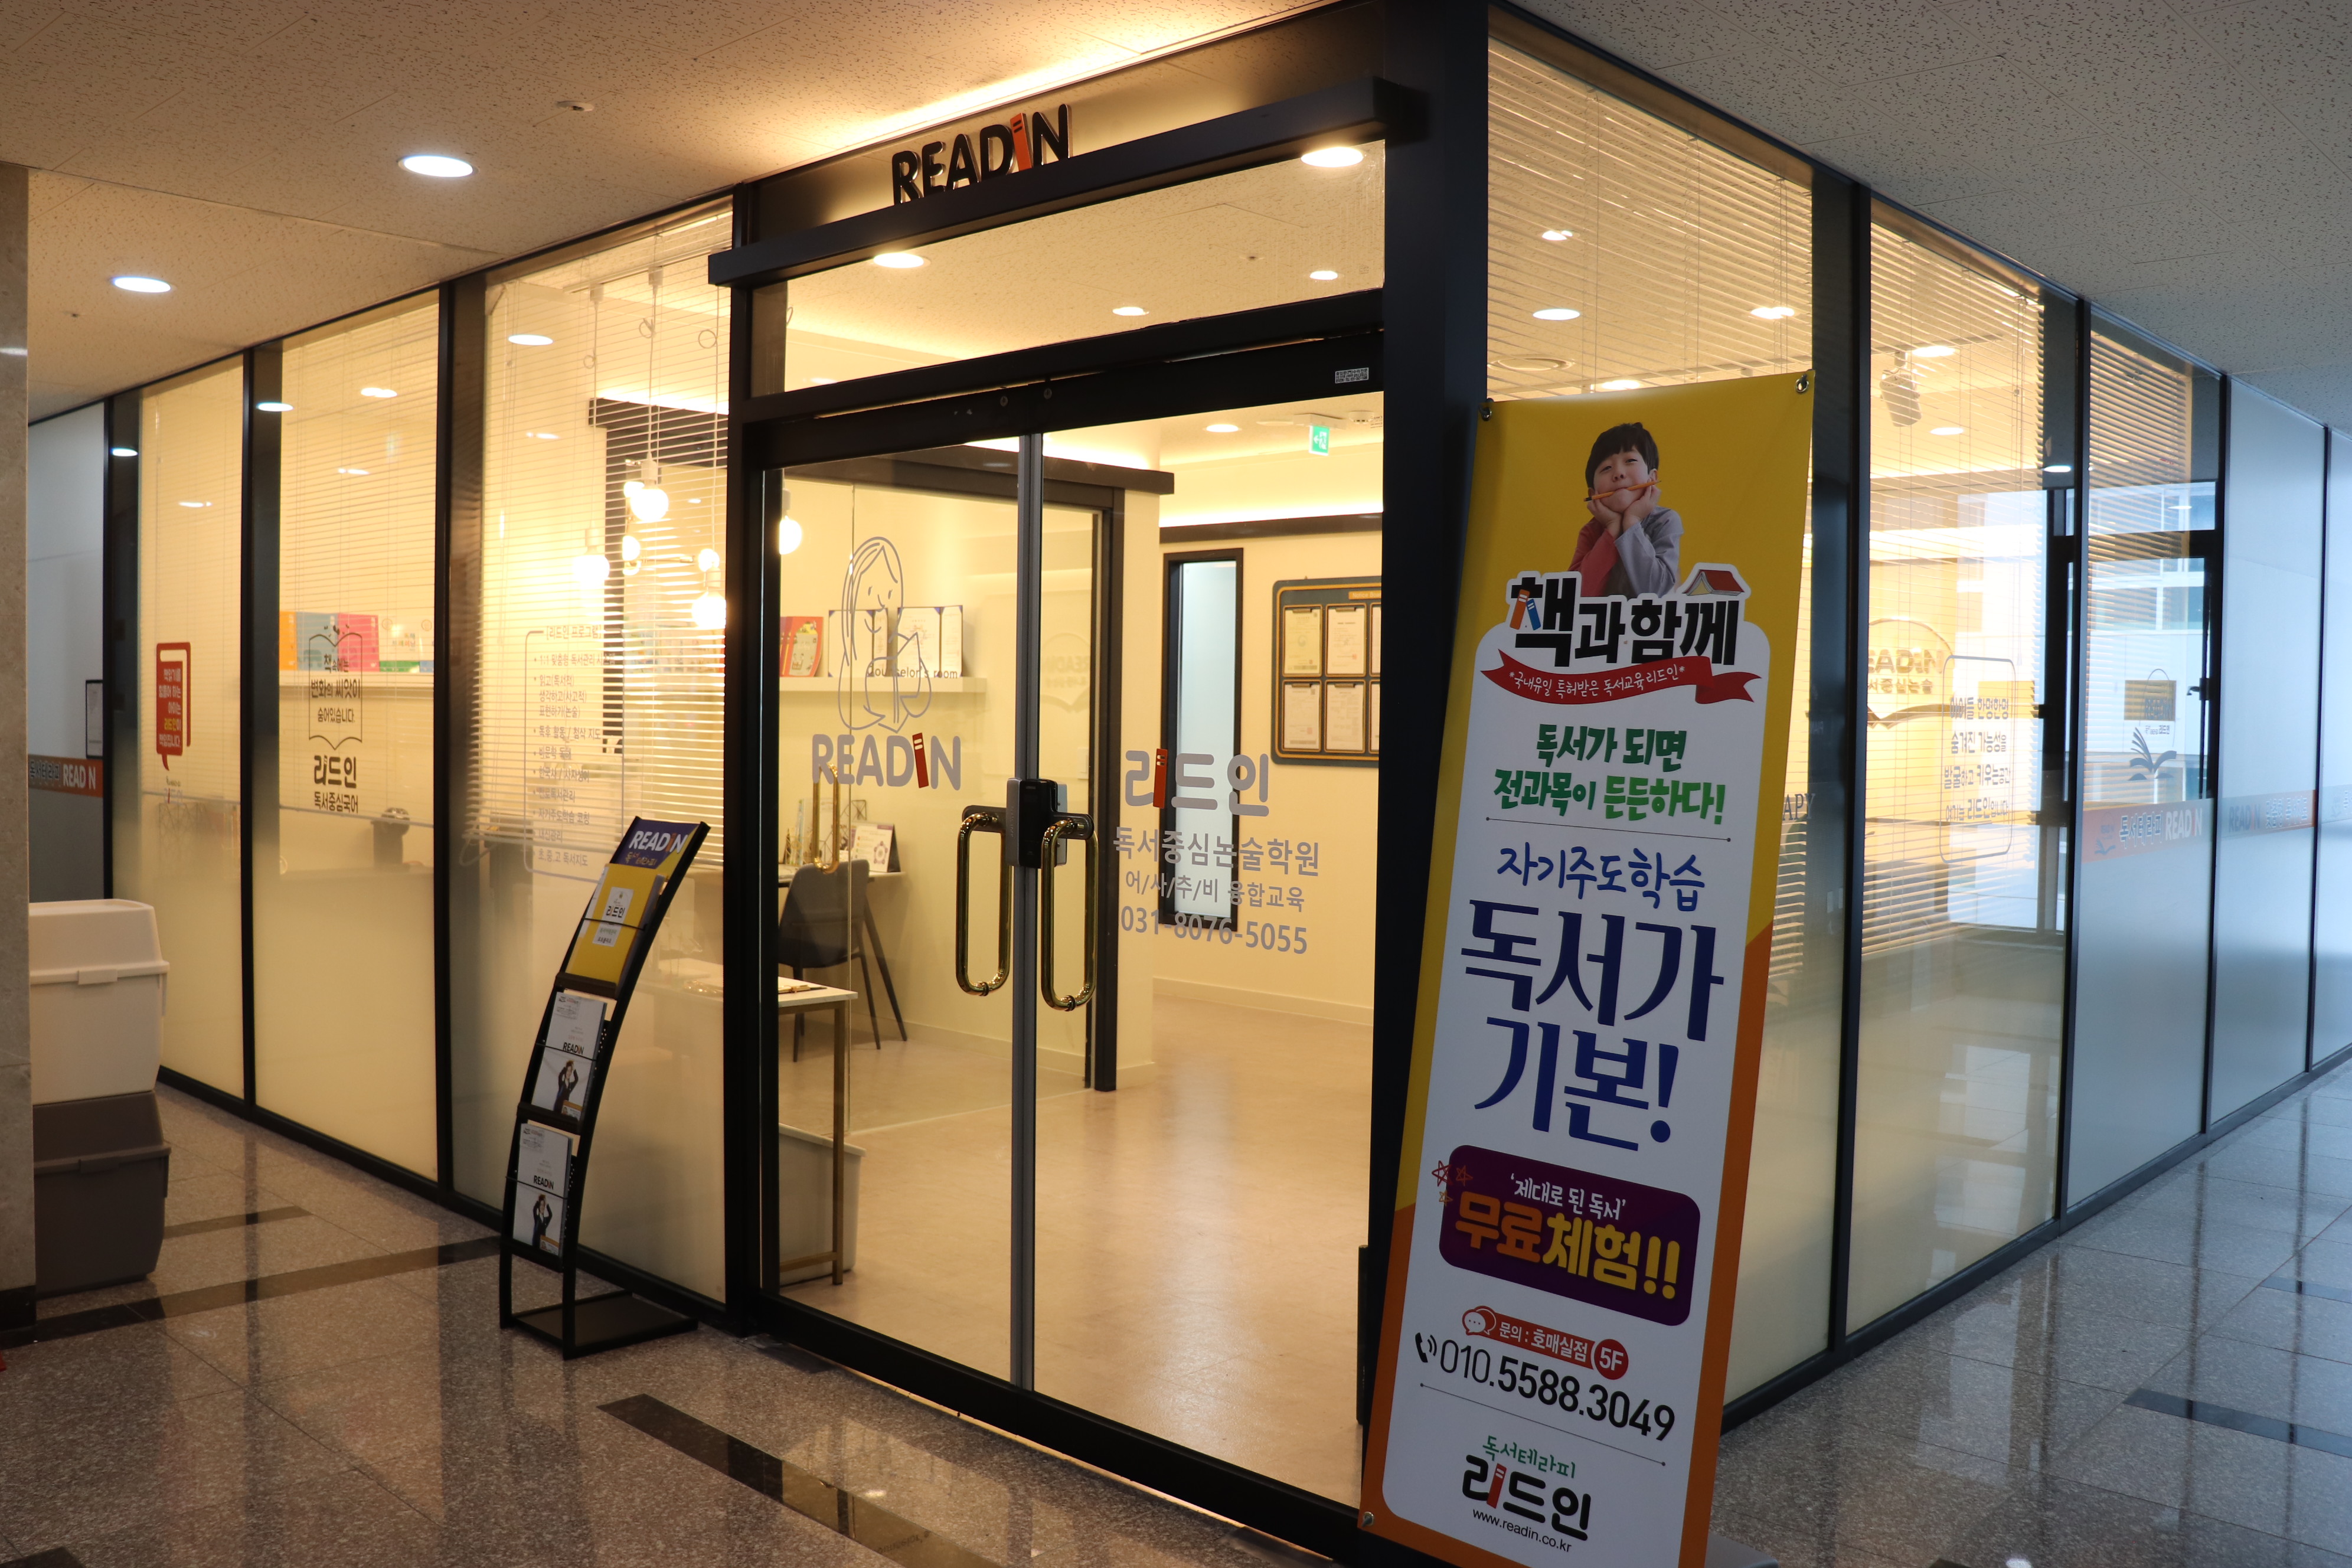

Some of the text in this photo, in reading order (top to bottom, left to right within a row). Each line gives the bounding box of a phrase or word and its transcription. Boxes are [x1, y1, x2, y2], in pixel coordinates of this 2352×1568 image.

[892, 104, 1073, 204] READIN
[311, 679, 361, 699] 변화의 씨앗이
[933, 670, 958, 679] room
[1556, 679, 1599, 699] 특허받은
[1950, 697, 1974, 720] 아이들
[588, 728, 601, 740] 지도
[1537, 724, 1687, 772] 독서가 되면
[1951, 731, 2007, 754] 숨겨진 가능성을
[314, 754, 357, 789] 리드인
[812, 732, 961, 790] READIN
[1125, 748, 1269, 816] 리드인
[315, 792, 358, 814] 독서중심국어
[1494, 769, 1726, 825] 전과목이 든든하다!
[629, 830, 688, 854] READIN
[2119, 811, 2163, 849] 독서테라피
[1113, 827, 1319, 877] 독서중심논술학원
[1227, 880, 1305, 912] 융합교육
[1497, 842, 1705, 912] 자기주도학습
[606, 906, 625, 918] 리드인
[1121, 906, 1308, 954] 031-8076-5055
[1461, 900, 1724, 1041] 독서가
[563, 1042, 584, 1056] READIN
[1474, 1017, 1678, 1151] 기본!
[533, 1175, 554, 1190] READIN
[1568, 1188, 1585, 1215] 된
[1455, 1191, 1680, 1299] 무료체험!!
[1531, 1328, 1588, 1363] 호매실점
[1599, 1347, 1624, 1371] 5F
[1439, 1339, 1675, 1442] 010.5588.3049
[1482, 1435, 1575, 1478] 독서테라피
[1462, 1455, 1591, 1541] 리드인
[1473, 1508, 1572, 1553] www.readin.co.kr
